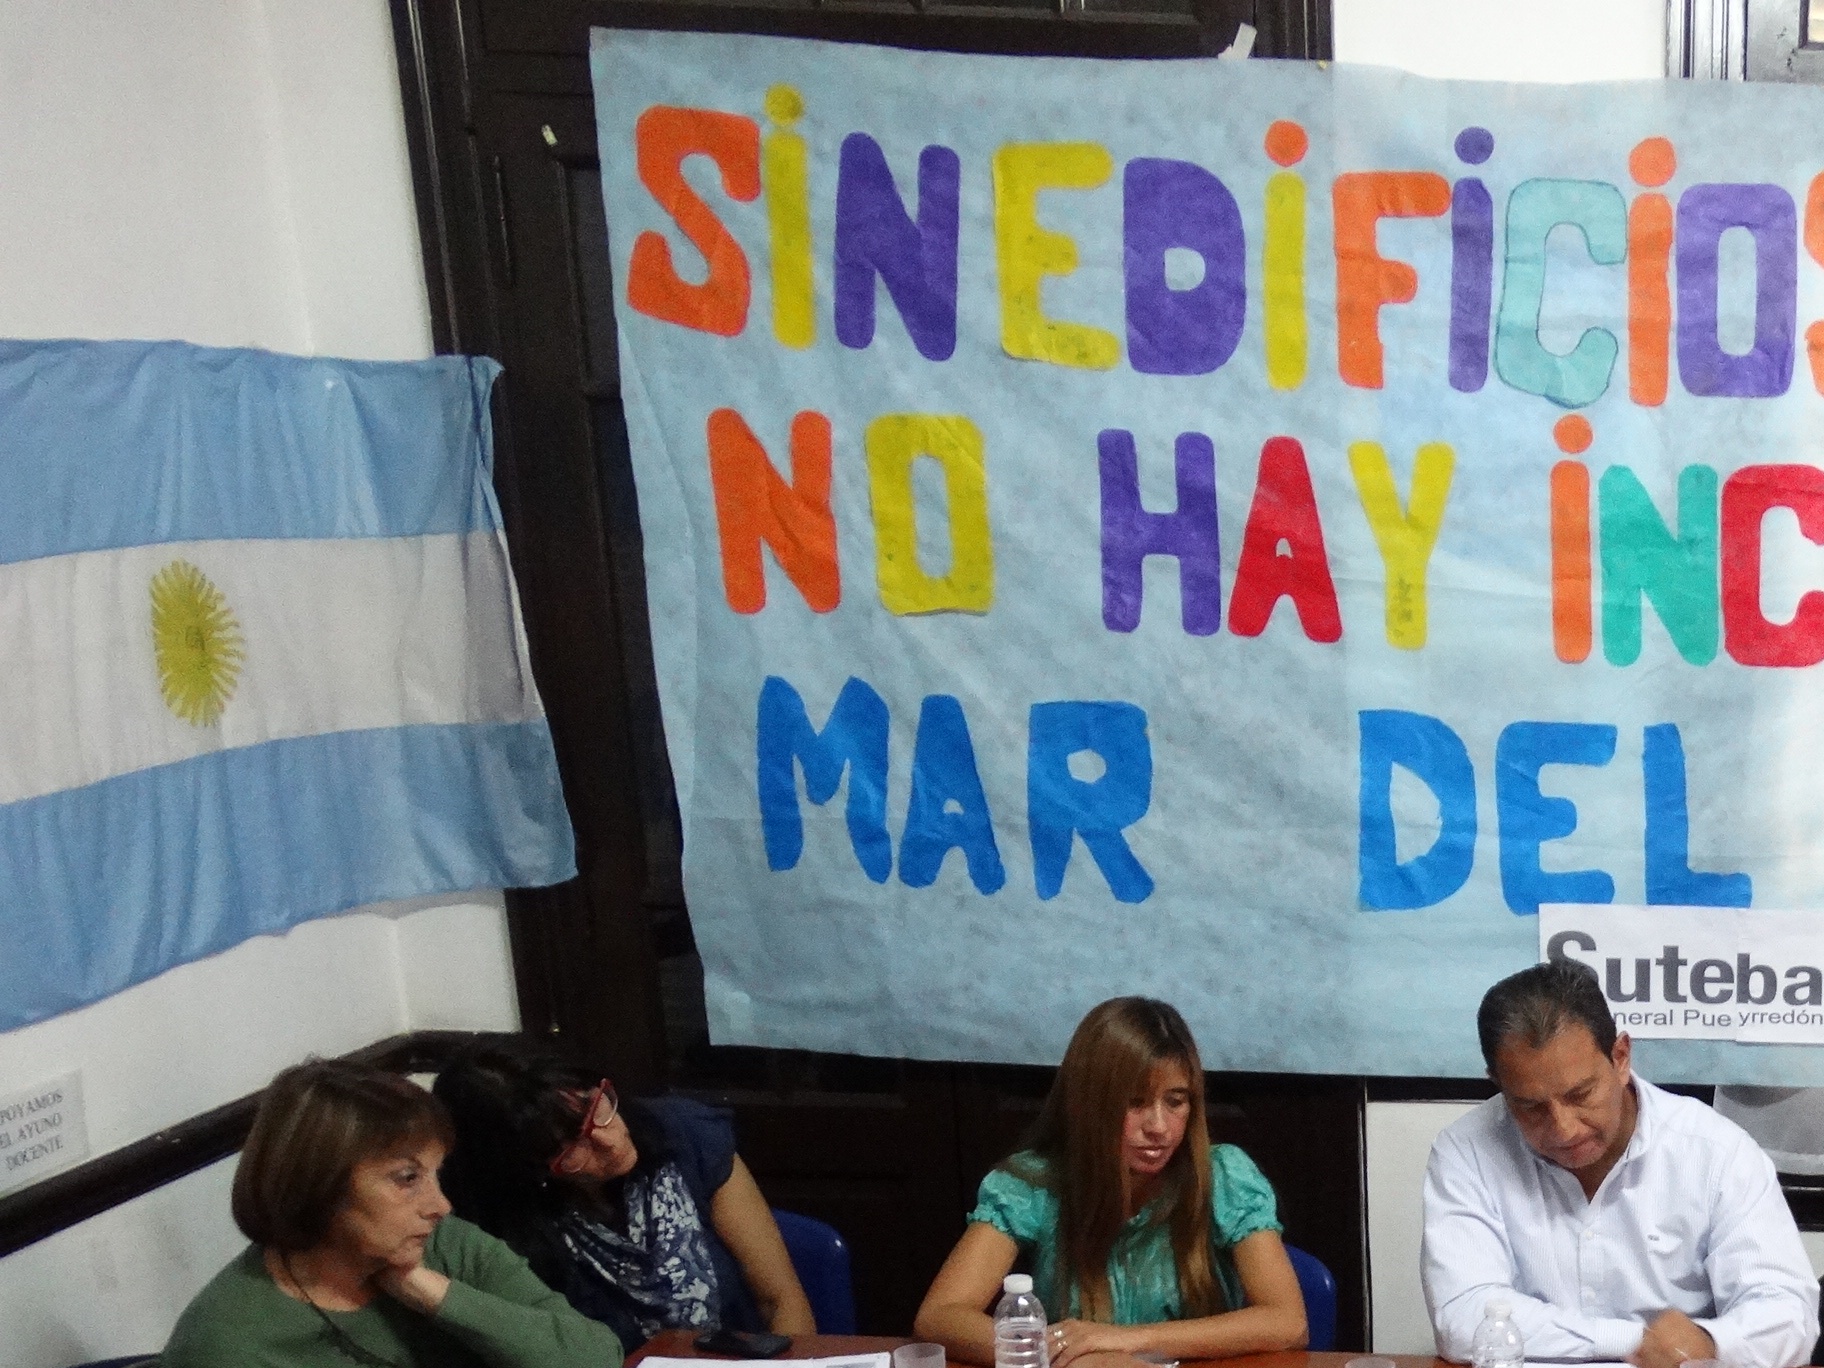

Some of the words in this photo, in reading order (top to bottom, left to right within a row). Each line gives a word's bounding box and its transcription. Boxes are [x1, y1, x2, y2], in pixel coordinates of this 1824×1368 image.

[706, 409, 993, 615] NO
[1098, 427, 1454, 651] HAY
[756, 676, 1155, 904] MAR
[1358, 710, 1753, 915] DEL
[1612, 1008, 1674, 1026] neral
